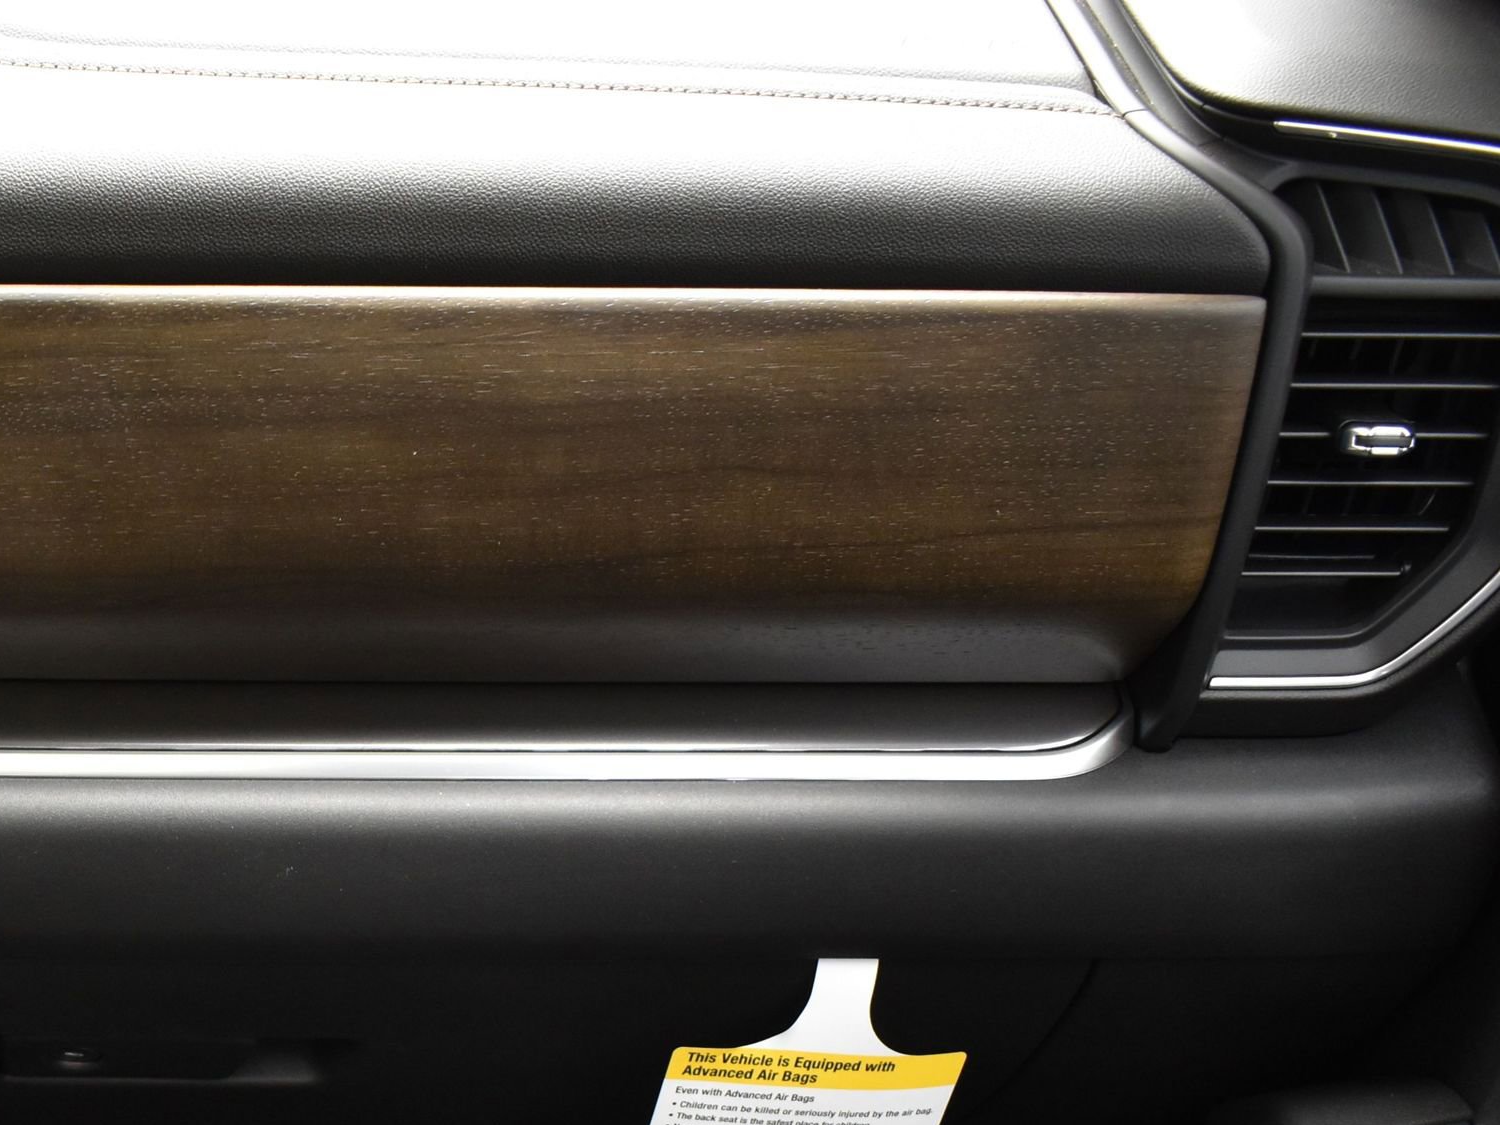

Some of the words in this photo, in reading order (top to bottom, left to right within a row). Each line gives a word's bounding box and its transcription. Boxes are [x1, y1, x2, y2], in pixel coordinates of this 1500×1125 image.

[688, 1052, 716, 1063] This
[722, 1053, 773, 1066] Vehicle
[778, 1057, 790, 1067] is
[794, 1057, 862, 1072] Equipped
[865, 1061, 896, 1072] with
[682, 1065, 753, 1079] Advanced
[757, 1071, 778, 1080] Air
[782, 1071, 817, 1084] Bags
[676, 1086, 698, 1094] Even
[702, 1088, 722, 1096] with
[725, 1090, 772, 1100] Advanced
[775, 1093, 789, 1101] Air
[791, 1094, 815, 1102] Bags
[680, 1101, 718, 1110] Children
[740, 1105, 752, 1113] be
[755, 1106, 780, 1115] killed
[795, 1109, 836, 1118] seriously
[838, 1110, 870, 1118] injured
[872, 1108, 882, 1118] by
[886, 1109, 899, 1117] the
[902, 1108, 913, 1116] air
[916, 1108, 932, 1116] bag.
[677, 1112, 692, 1120] The
[695, 1113, 716, 1122] back
[719, 1116, 737, 1124] seat
[740, 1116, 747, 1124] is
[750, 1117, 764, 1125] the
